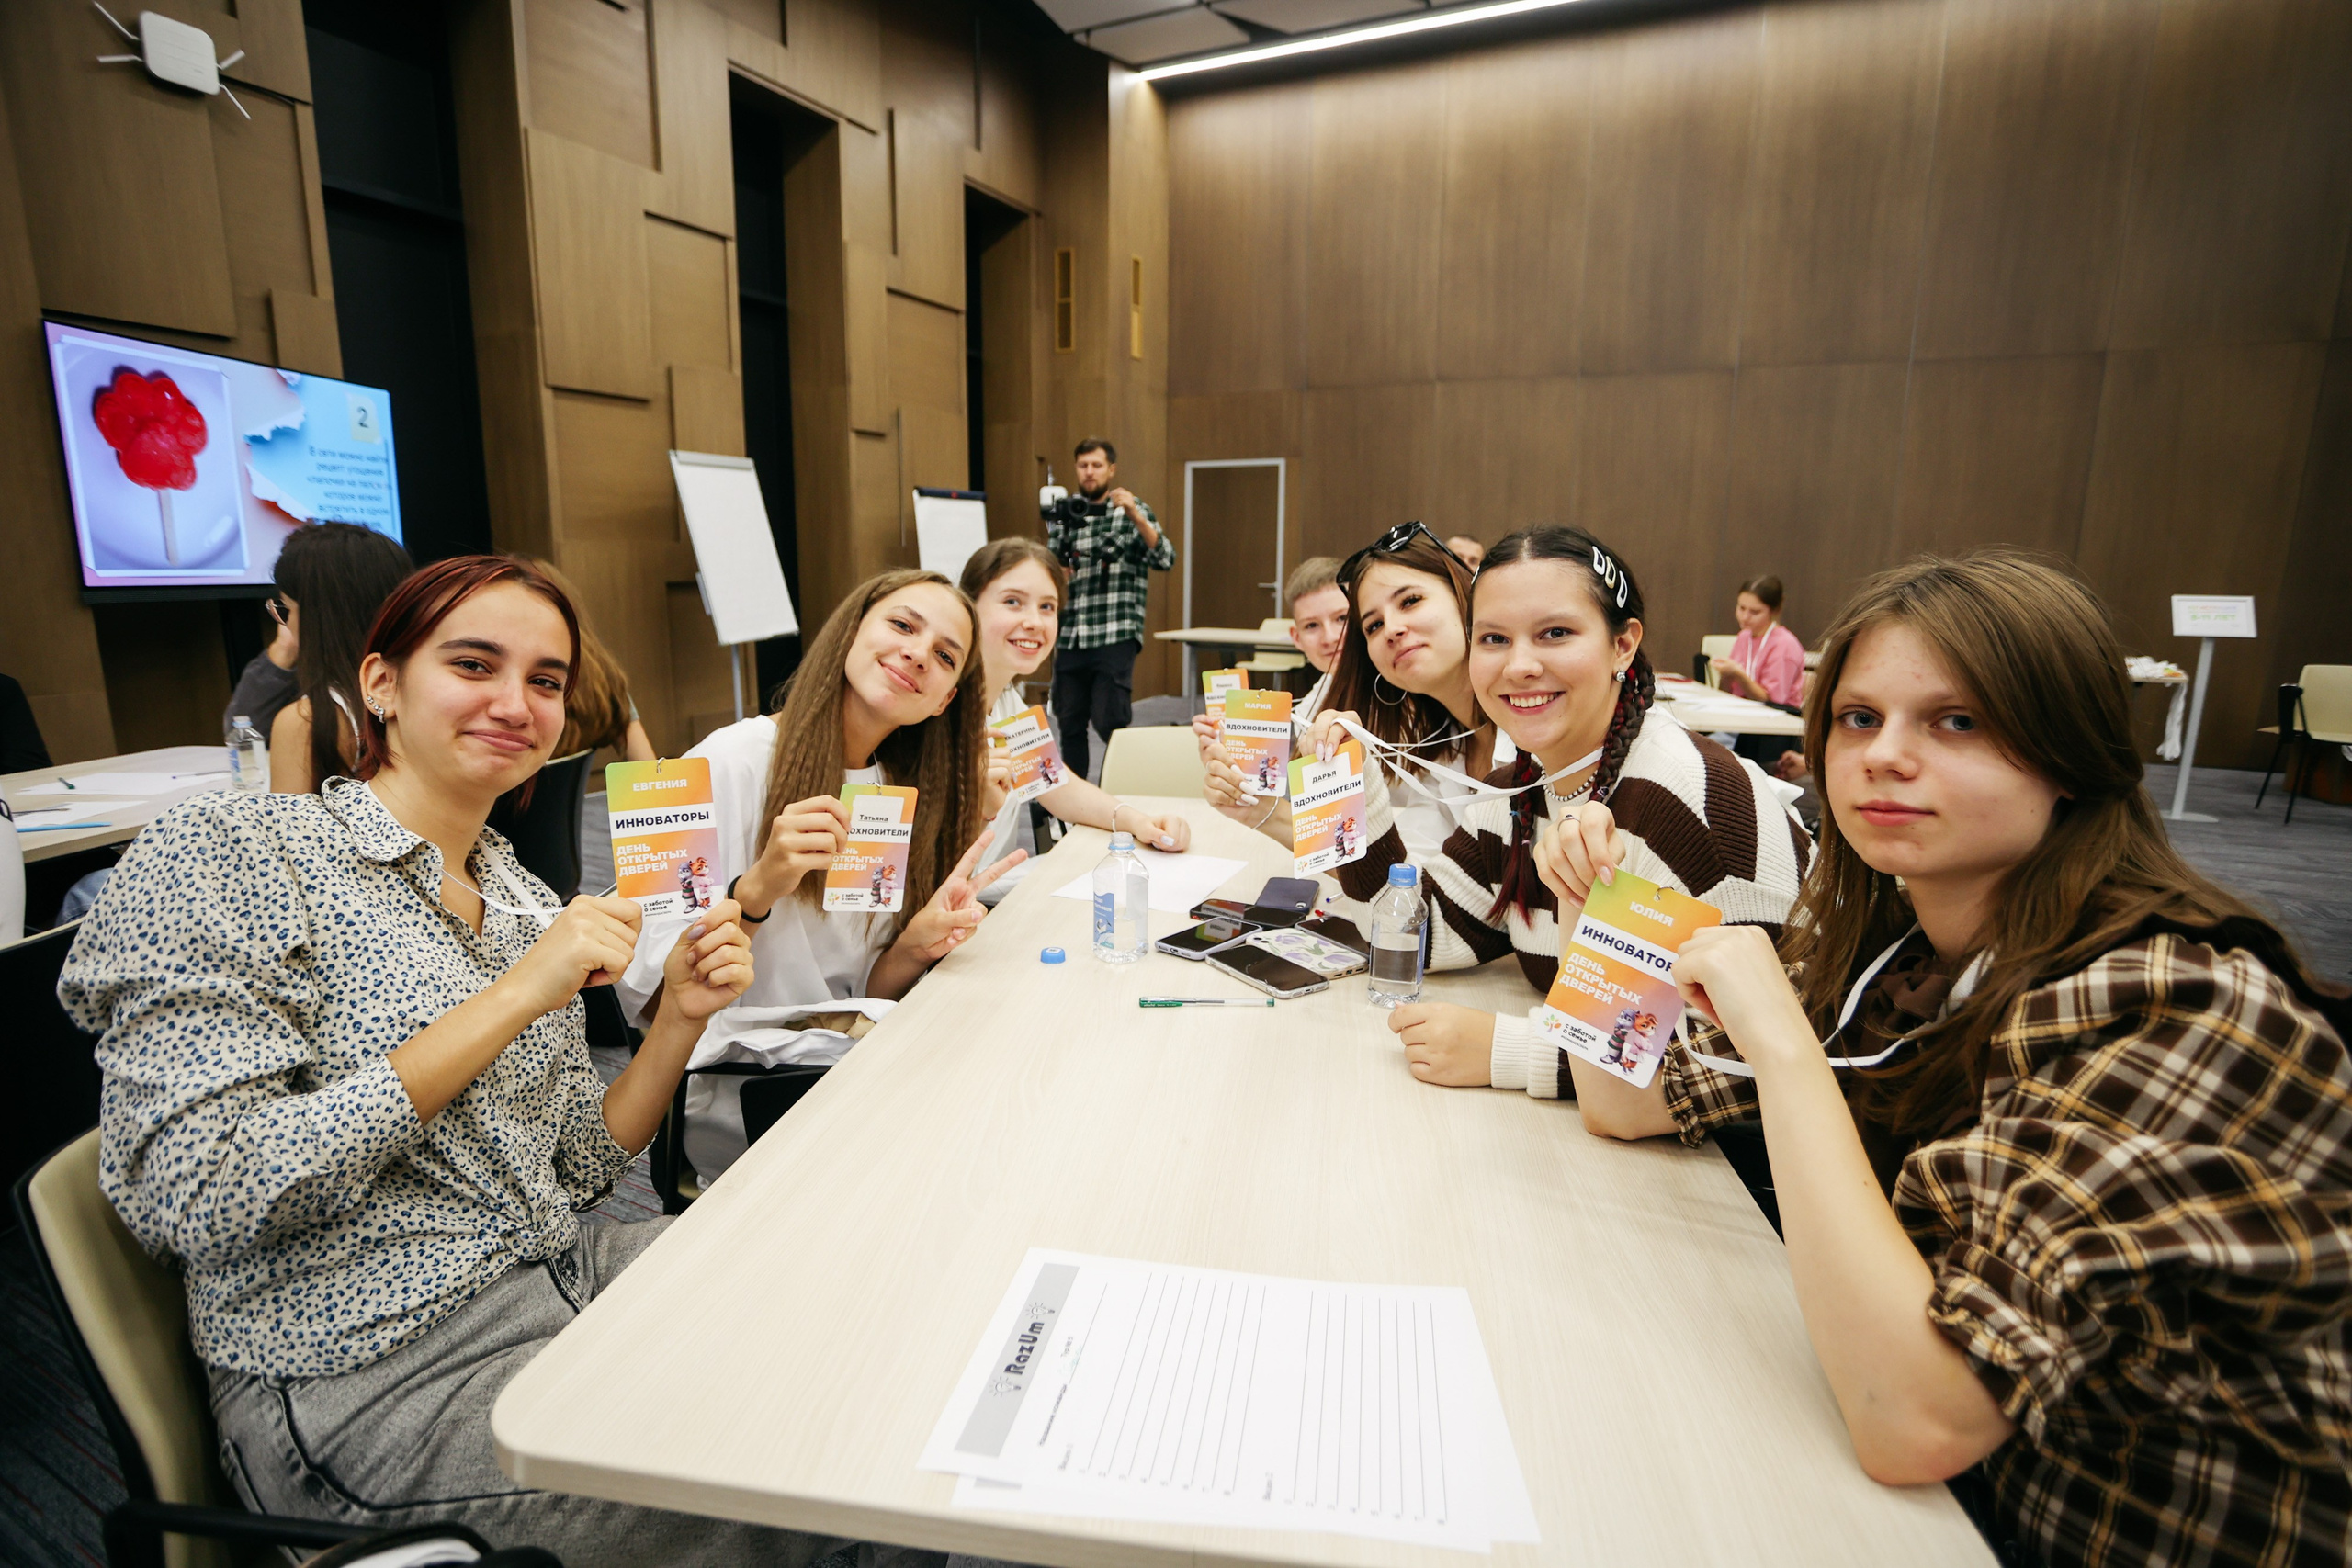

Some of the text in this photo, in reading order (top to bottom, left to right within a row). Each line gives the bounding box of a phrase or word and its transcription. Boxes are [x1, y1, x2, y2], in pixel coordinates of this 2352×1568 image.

[356, 406, 370, 429] 2
[1244, 702, 1272, 710] МАРИЯ
[1226, 723, 1288, 733] ВДОХНОВИТЕЛИ
[1010, 733, 1050, 753] ОХНОВИТЕЛИ
[1312, 770, 1337, 784] ДАРЬЯ
[632, 779, 687, 792] ЕВГЕНИЯ
[1294, 780, 1362, 807] ВДОХНОВИТЕЛИ
[616, 811, 710, 829] ИННОВАТОРЫ
[859, 814, 888, 822] Татьяна
[1295, 814, 1317, 828] ДЕНЬ
[1295, 813, 1342, 834] ОТКРЫТЫХ
[846, 828, 909, 837] ОХНОВИТЕЛИ
[1295, 826, 1329, 842] ДВЕРЕЙ
[616, 843, 651, 857] ДЕНЬ
[617, 849, 688, 865] ОТКРЫТЫХ
[833, 855, 884, 863] ОТКРЫТЫХ
[618, 860, 668, 877] ДВЕРЕЙ
[831, 863, 867, 872] ДВЕРЕЙ
[649, 898, 673, 907] заботой
[1629, 901, 1675, 928] ЮЛИЯ
[1581, 925, 1674, 973] ИННОВАТОР
[1566, 953, 1606, 976] ДЕНЬ
[1558, 973, 1614, 1005] ДВЕРЕЙ
[1565, 964, 1644, 1006] ОТКРЫТЫХ
[1568, 1032, 1588, 1043] семье
[1570, 1026, 1597, 1042] заботой
[1003, 1322, 1045, 1376] RazUm
